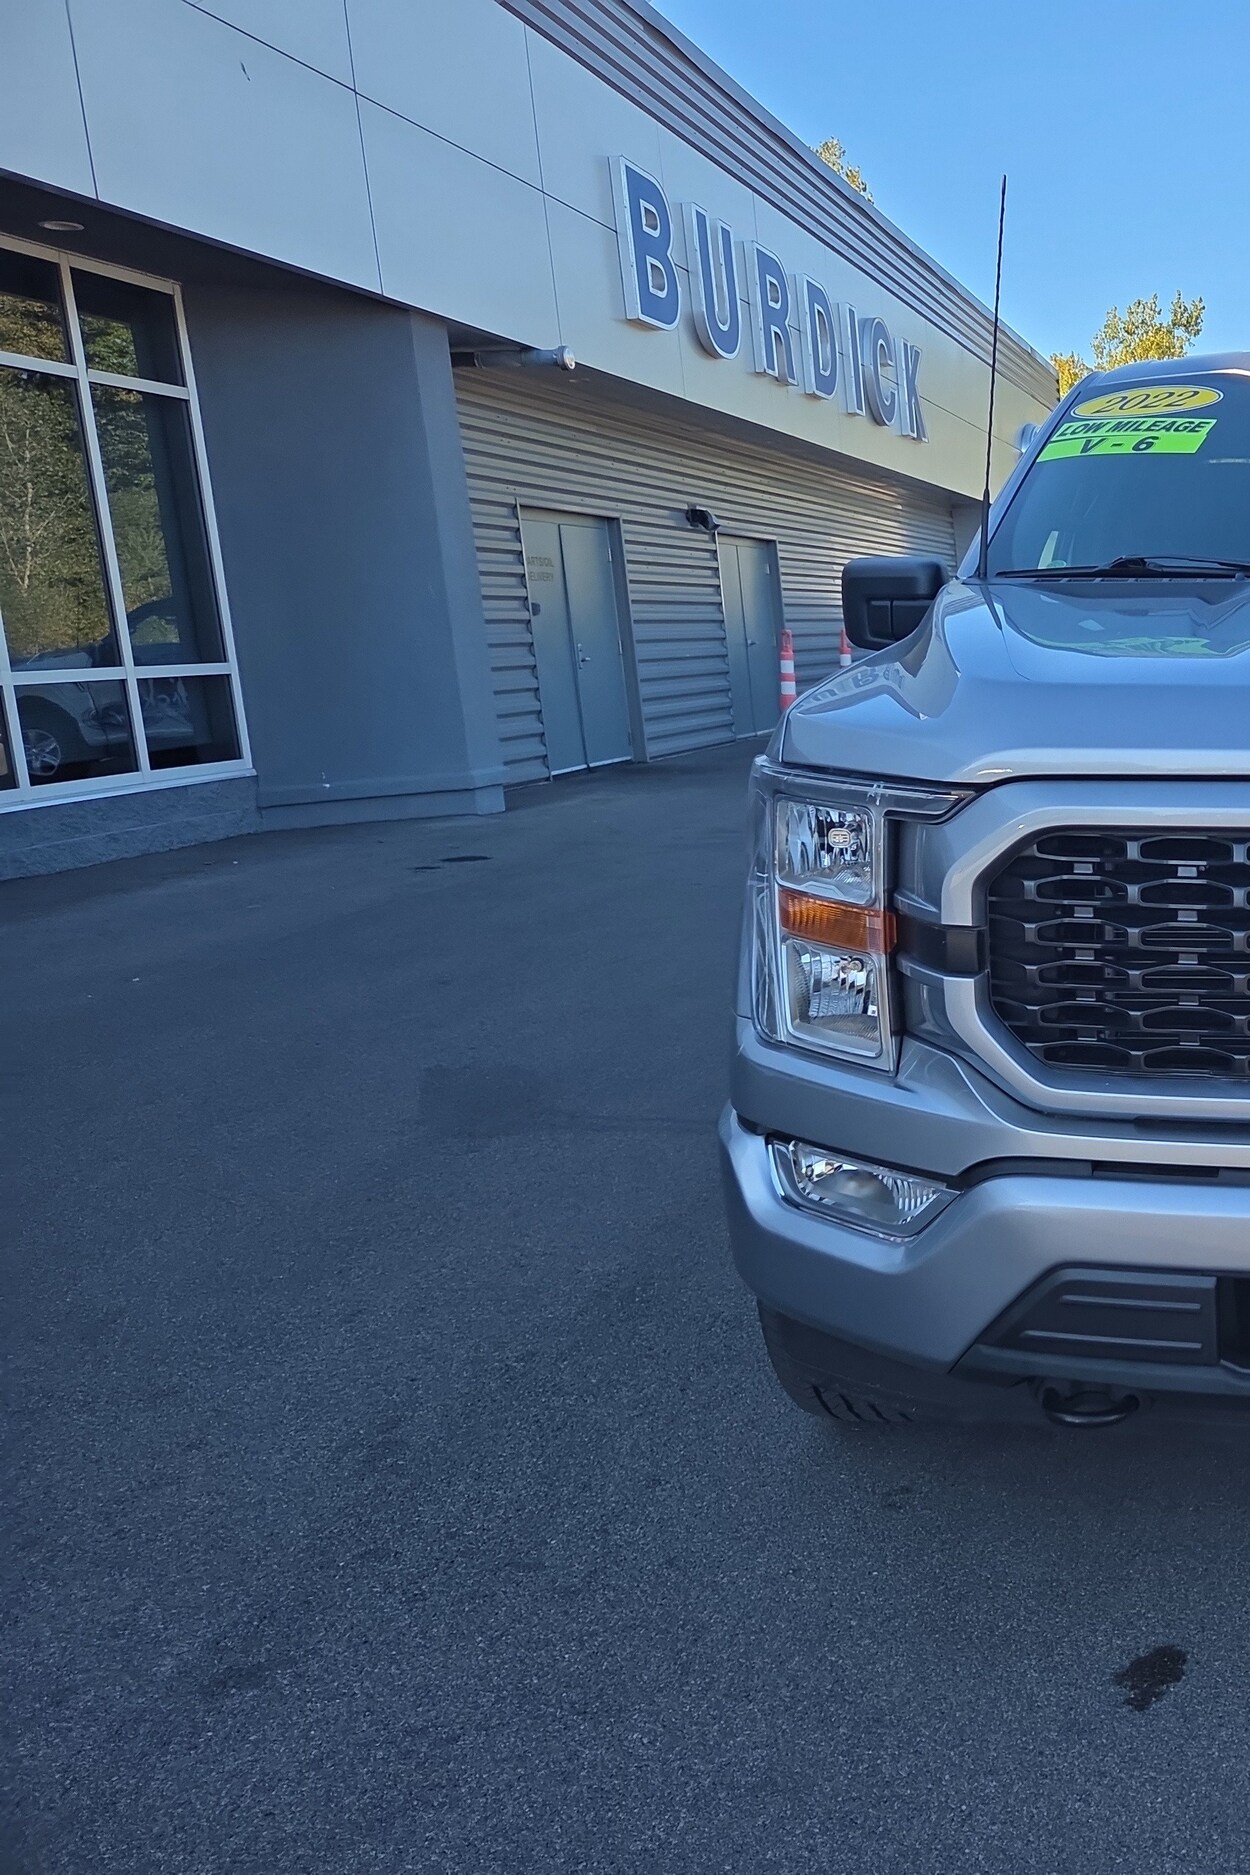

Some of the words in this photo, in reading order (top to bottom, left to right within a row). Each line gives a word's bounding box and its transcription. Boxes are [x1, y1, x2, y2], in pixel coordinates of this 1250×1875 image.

[608, 154, 929, 443] BURDICK
[1091, 389, 1201, 414] 2022
[1058, 421, 1105, 437] LOW
[1105, 420, 1211, 434] MILEAGE
